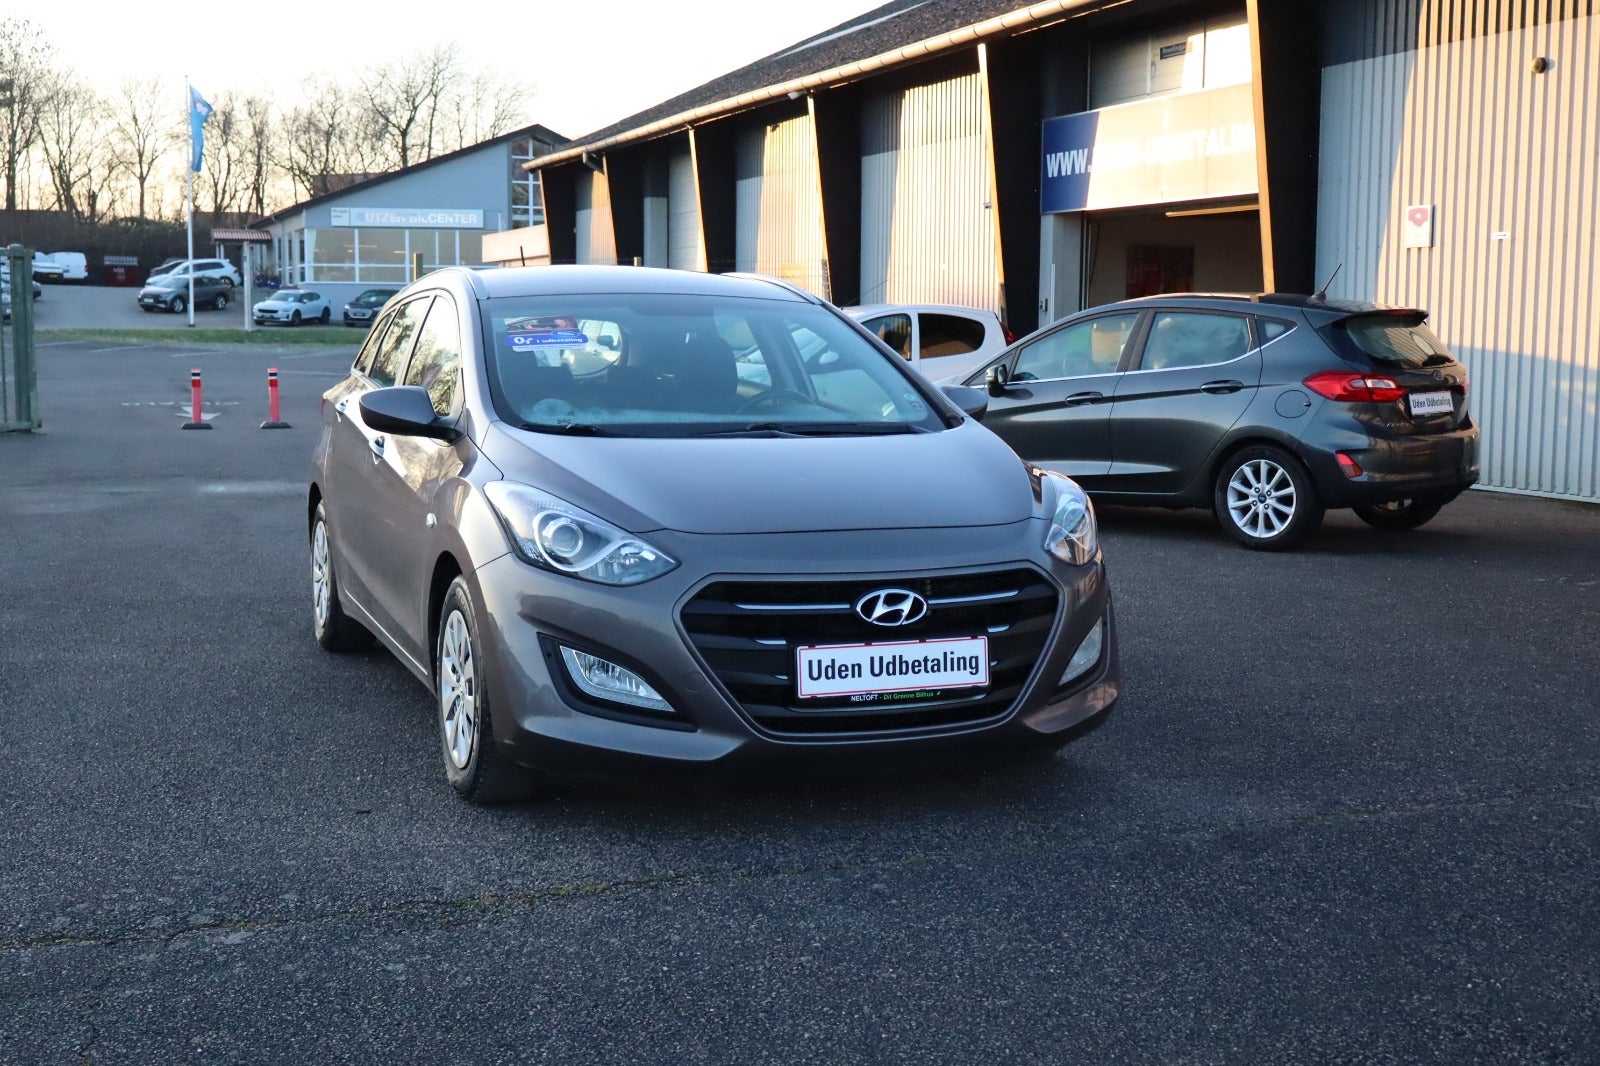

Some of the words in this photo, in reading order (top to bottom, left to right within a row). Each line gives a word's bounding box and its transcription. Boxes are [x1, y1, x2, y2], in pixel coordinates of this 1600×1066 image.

[1411, 399, 1425, 408] Uden
[1426, 396, 1451, 407] Udbetaling
[808, 659, 862, 681] Uden
[870, 651, 980, 677] Udbetaling
[851, 694, 878, 702] NELTOFT
